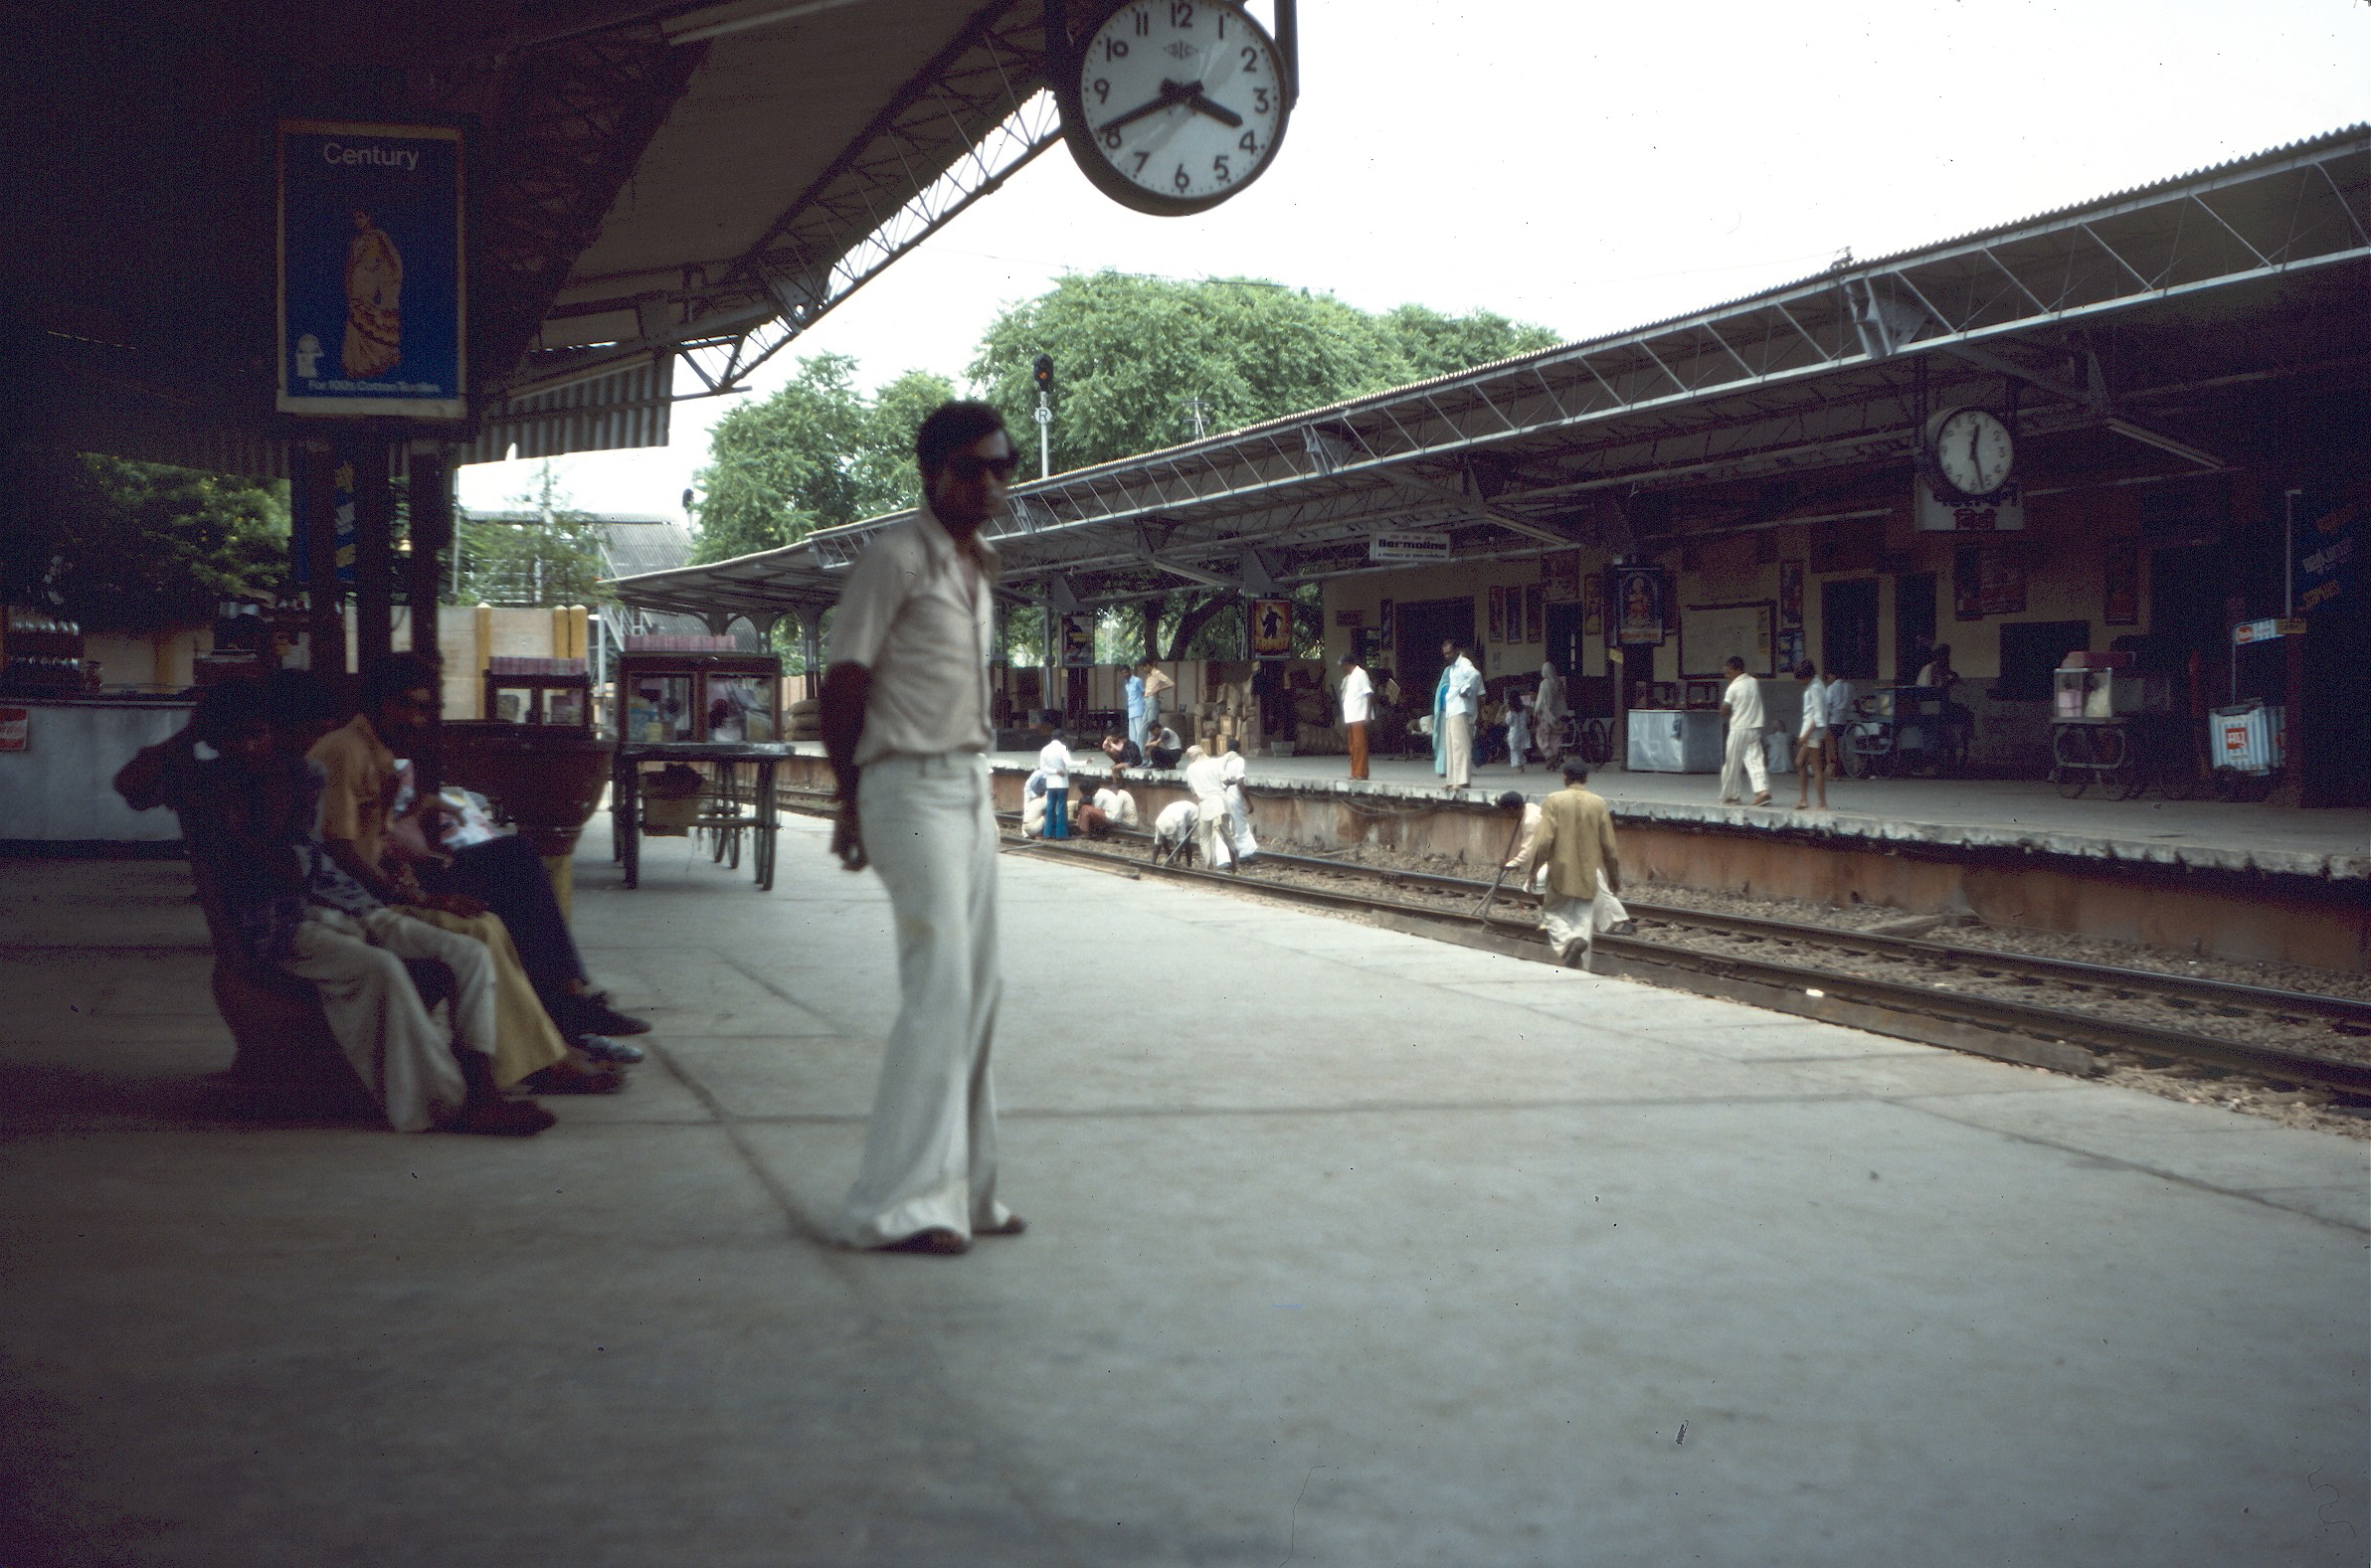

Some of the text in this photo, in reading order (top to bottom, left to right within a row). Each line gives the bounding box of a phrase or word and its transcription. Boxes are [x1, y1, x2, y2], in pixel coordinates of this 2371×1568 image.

[1136, 11, 1149, 36] 11
[1171, 2, 1193, 28] 12
[1218, 14, 1224, 40] 1
[1106, 37, 1129, 62] 10
[1240, 47, 1258, 73] 2
[1095, 79, 1111, 104] 9
[1253, 87, 1269, 114] 3
[1105, 125, 1122, 150] 8
[1239, 130, 1257, 154] 4
[323, 142, 420, 171] Century
[1134, 152, 1150, 173] 7
[1213, 155, 1229, 181] 5
[1175, 164, 1189, 189] 6
